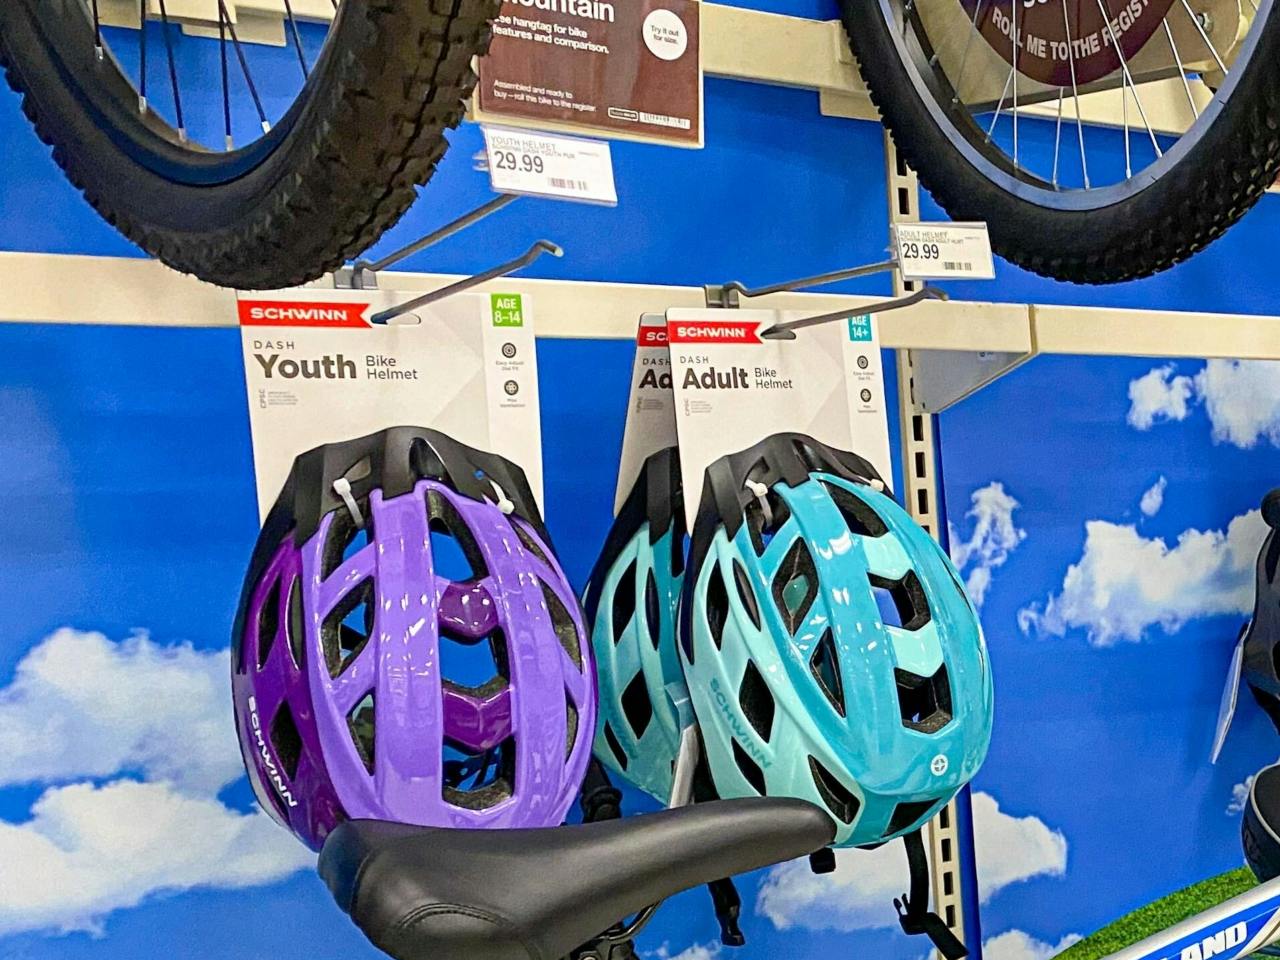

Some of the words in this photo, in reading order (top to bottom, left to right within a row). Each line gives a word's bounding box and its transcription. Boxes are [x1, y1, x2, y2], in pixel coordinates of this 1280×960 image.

[501, 0, 615, 23] ountain
[513, 16, 552, 34] hangtag
[553, 24, 567, 34] for
[568, 26, 588, 39] bike
[992, 6, 1023, 47] ROLL
[1026, 34, 1047, 59] ME
[1049, 41, 1069, 61] TO
[1072, 33, 1100, 59] THE
[492, 24, 533, 40] features
[534, 31, 552, 44] and
[554, 36, 610, 54] comparison.
[493, 150, 544, 174] 29.99
[902, 242, 939, 260] 29.99
[495, 298, 517, 310] AGE
[250, 306, 348, 322] SCHWINN
[493, 310, 521, 324] 8-14
[851, 315, 868, 327] AGE
[676, 326, 746, 338] SCHWINN
[852, 327, 869, 338] 14+
[253, 339, 296, 351] DASH
[253, 353, 358, 380] Youth
[365, 355, 397, 368] Bike
[679, 355, 710, 364] DASH
[366, 367, 419, 380] Helmet
[682, 366, 750, 390] Adult
[754, 367, 777, 378] Bike
[755, 378, 793, 390] Helmet
[248, 696, 298, 808] SCHWINN
